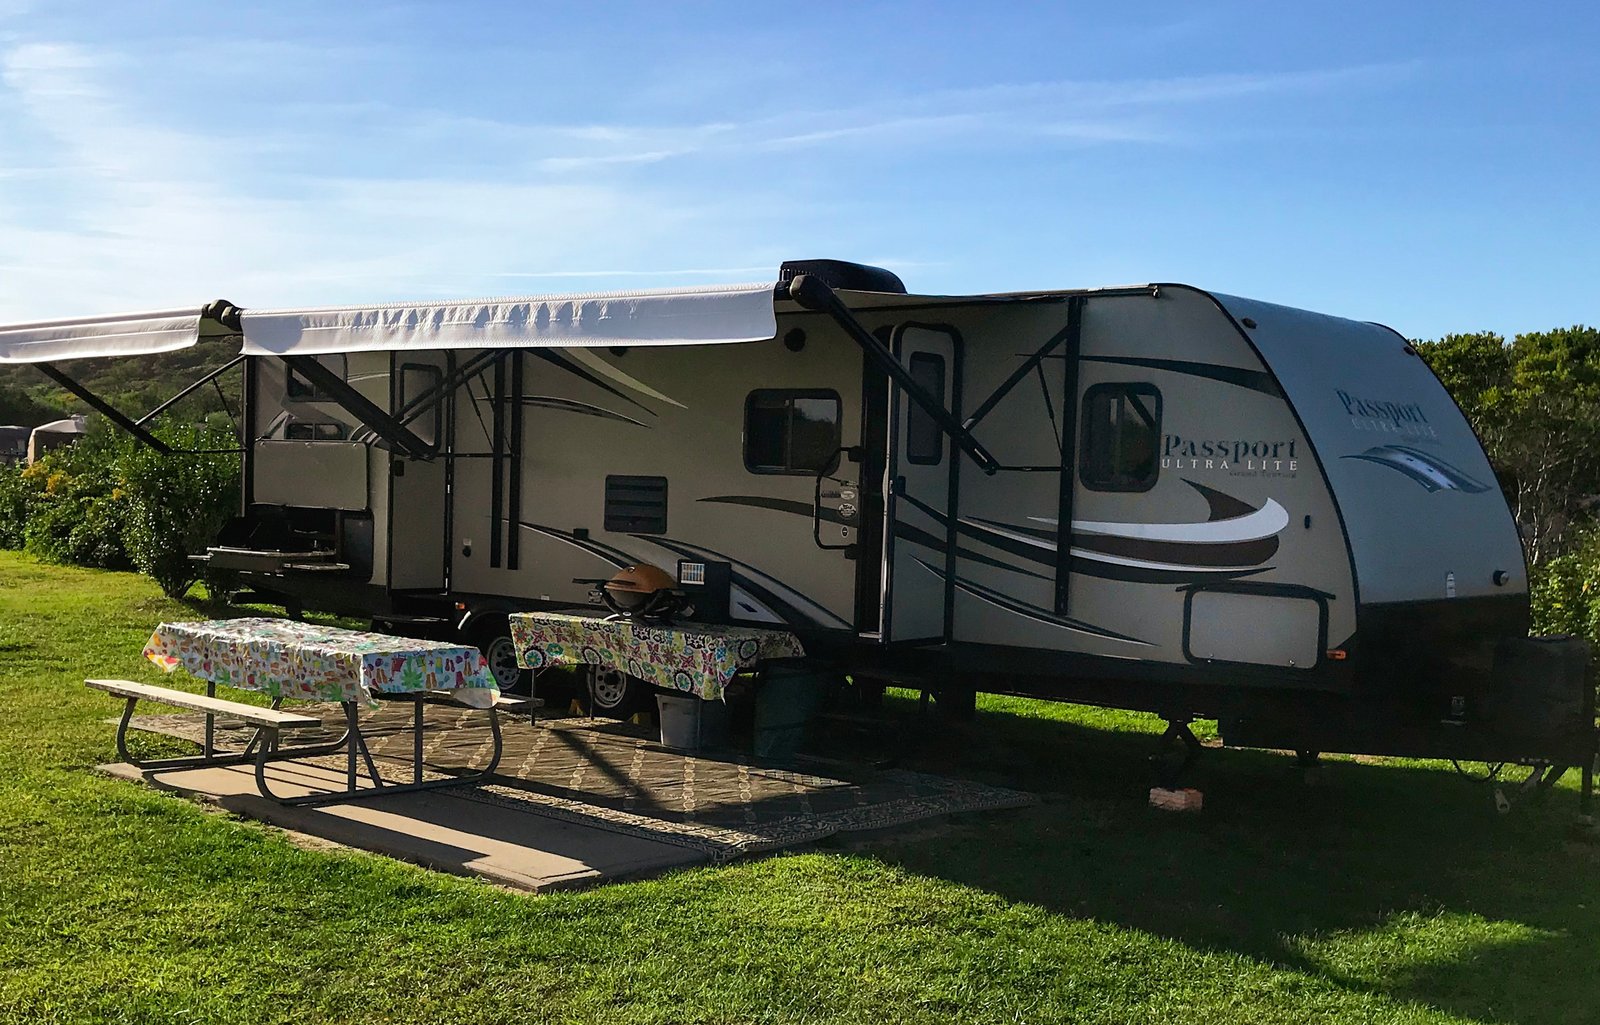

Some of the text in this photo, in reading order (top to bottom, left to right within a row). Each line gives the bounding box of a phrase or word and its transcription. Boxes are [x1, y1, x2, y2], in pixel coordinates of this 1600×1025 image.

[1334, 388, 1428, 428] Passport
[1351, 417, 1399, 433] ULTRA
[1163, 433, 1298, 463] Passport
[1161, 458, 1297, 471] ULTRA LITE
